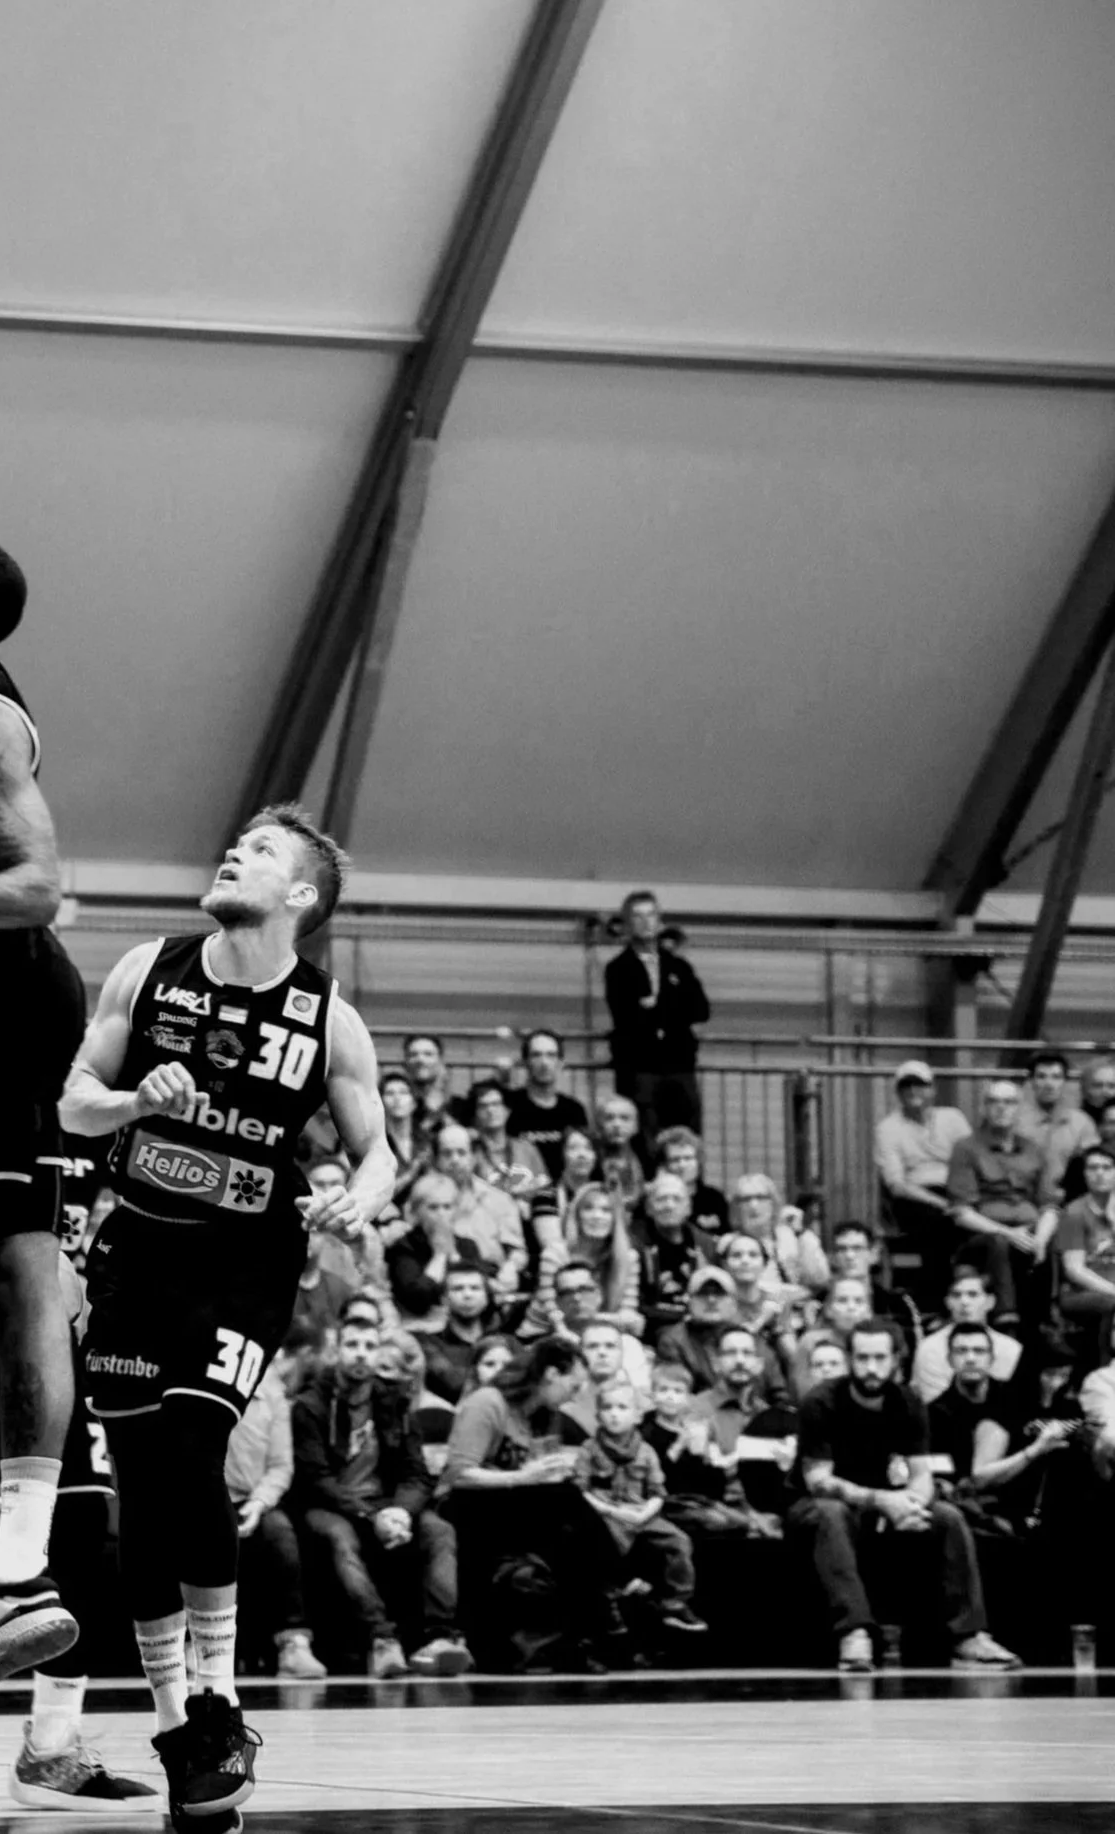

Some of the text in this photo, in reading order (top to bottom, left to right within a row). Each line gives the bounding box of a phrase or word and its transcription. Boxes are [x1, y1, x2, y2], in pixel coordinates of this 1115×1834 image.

[247, 1022, 319, 1091] 30
[136, 1145, 221, 1188] Helios
[206, 1327, 264, 1399] 30
